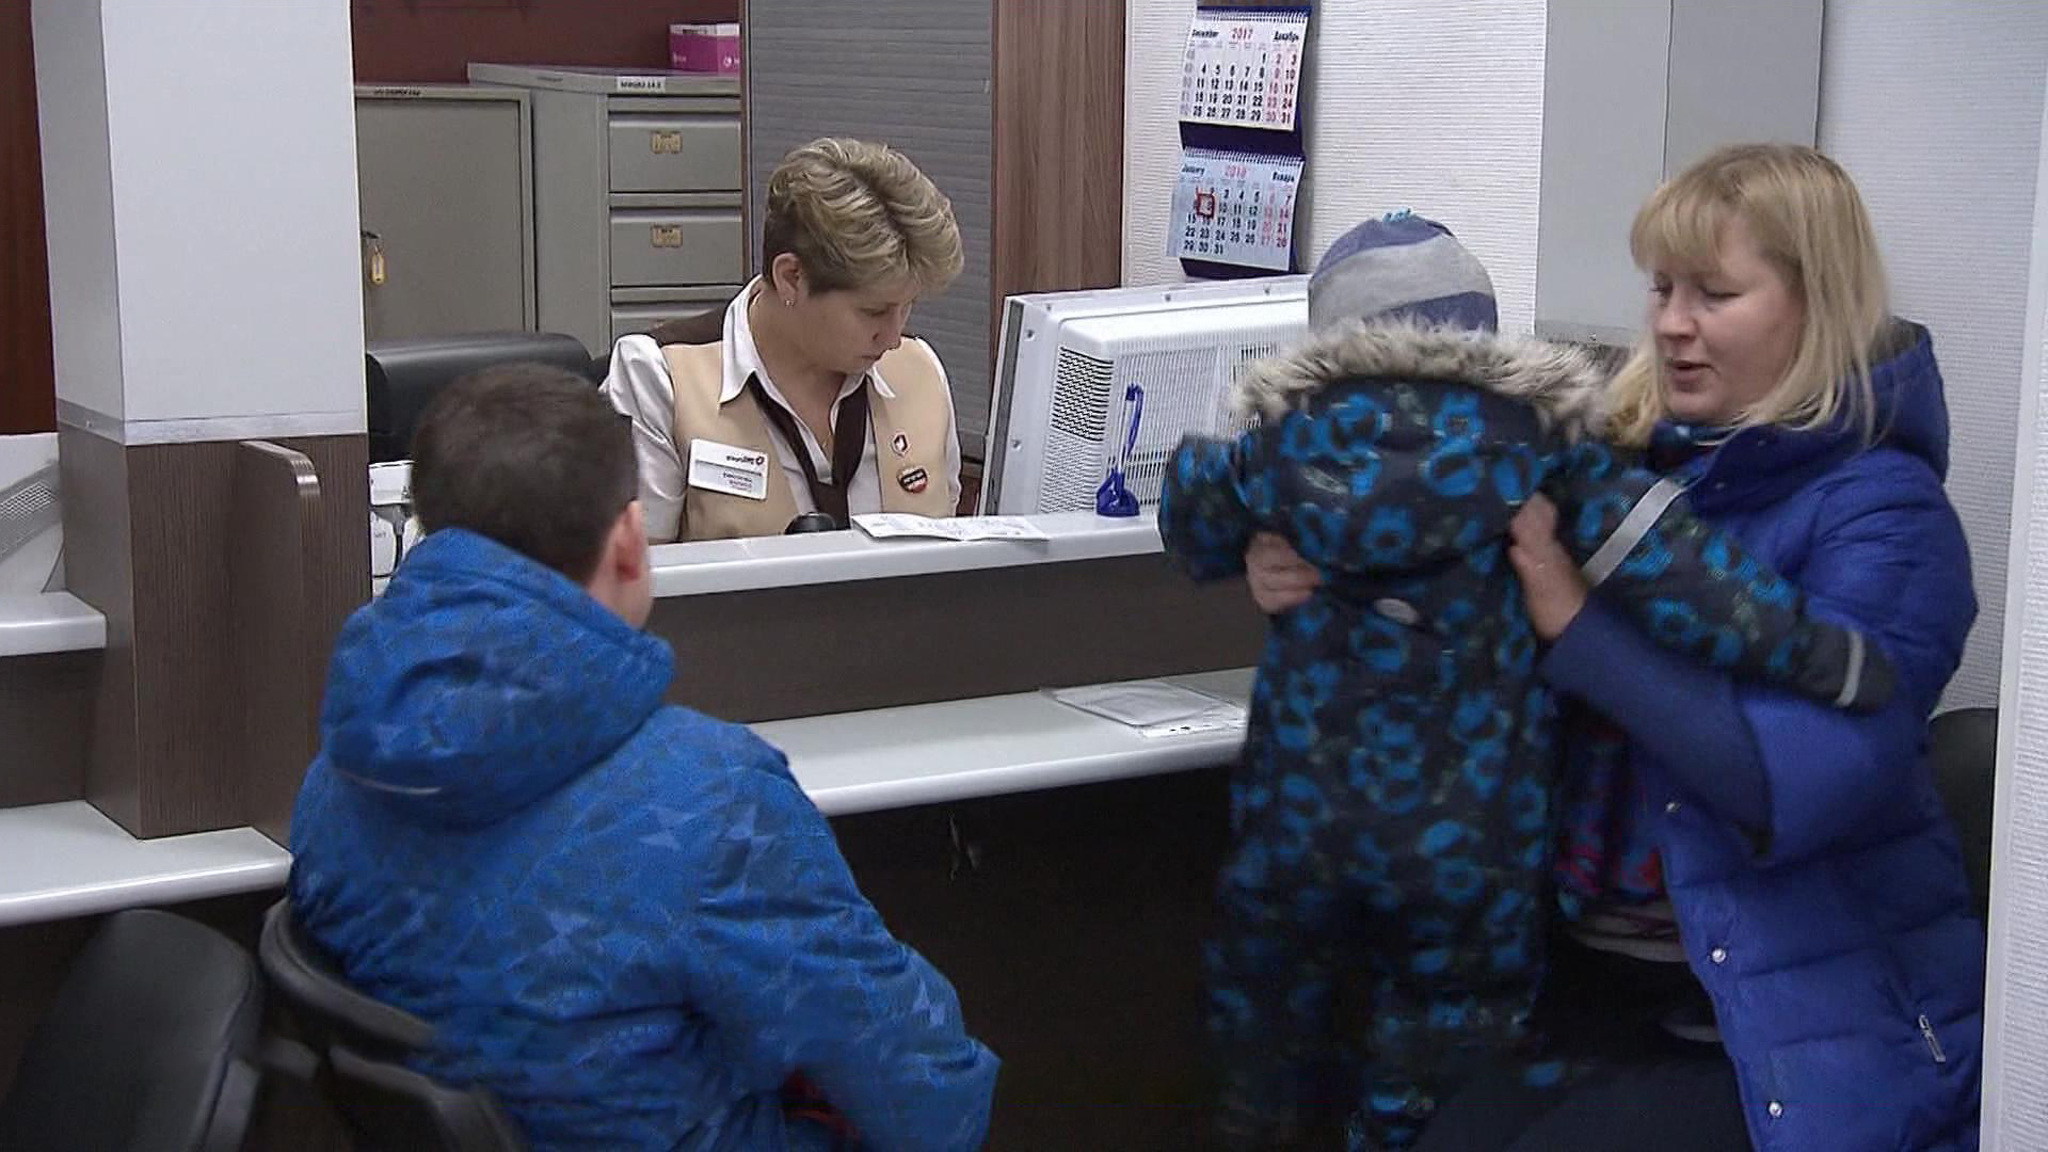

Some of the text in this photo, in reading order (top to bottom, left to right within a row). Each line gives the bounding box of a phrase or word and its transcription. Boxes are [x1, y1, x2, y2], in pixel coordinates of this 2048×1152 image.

[1230, 28, 1253, 39] 2017
[1262, 53, 1297, 65] 1 2 3
[1201, 64, 1206, 74] 4
[1216, 64, 1221, 75] 5
[1230, 65, 1235, 76] 6
[1244, 66, 1250, 77] 7
[1285, 70, 1295, 79] 10
[1197, 78, 1205, 88] 11
[1211, 79, 1219, 89] 12
[1225, 80, 1234, 90] 13
[1240, 81, 1248, 91] 14
[1254, 82, 1263, 92] 15
[1284, 85, 1294, 94] 17
[1195, 92, 1203, 102] 18
[1209, 93, 1218, 103] 19
[1222, 94, 1232, 104] 20
[1237, 95, 1247, 105] 21
[1252, 97, 1262, 107] 22
[1282, 99, 1292, 109] 24
[1193, 106, 1202, 116] 25
[1206, 107, 1216, 117] 26
[1220, 108, 1231, 118] 27
[1250, 110, 1261, 121] 29
[1281, 113, 1290, 124] 31
[1239, 191, 1244, 200] 4
[1286, 196, 1291, 205] 7
[1234, 205, 1241, 215] 11
[1249, 206, 1258, 215] 12
[1217, 218, 1225, 226] 17
[1247, 221, 1256, 230] 19
[1278, 223, 1287, 233] 21
[1185, 227, 1195, 237] 22
[1200, 229, 1209, 238] 23
[1215, 231, 1225, 241] 24
[1184, 241, 1224, 254] 29 30 31
